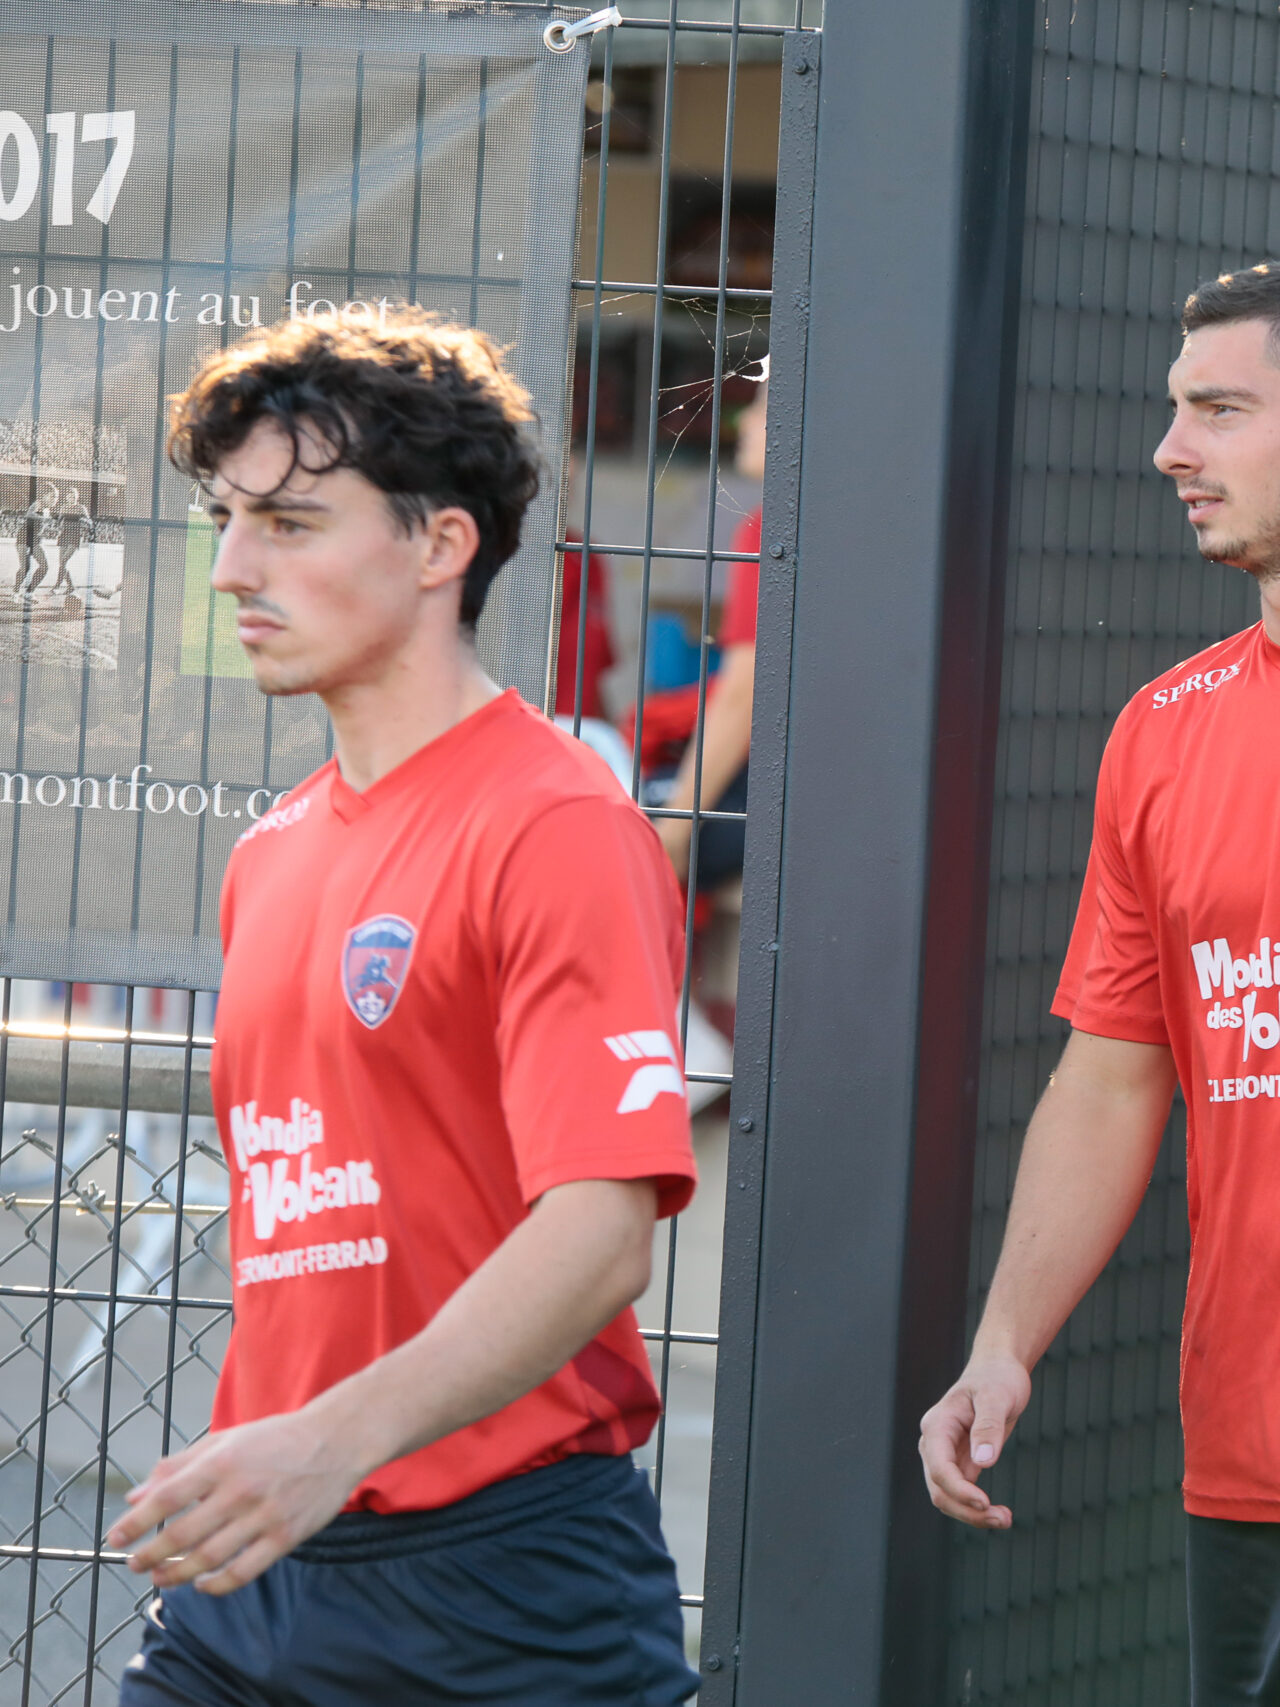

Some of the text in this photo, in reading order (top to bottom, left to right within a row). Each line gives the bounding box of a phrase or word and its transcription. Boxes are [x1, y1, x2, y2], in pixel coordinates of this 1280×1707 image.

[0, 110, 135, 225] 017
[0, 266, 181, 332] jouent
[197, 293, 264, 327] au
[1207, 1001, 1243, 1029] des
